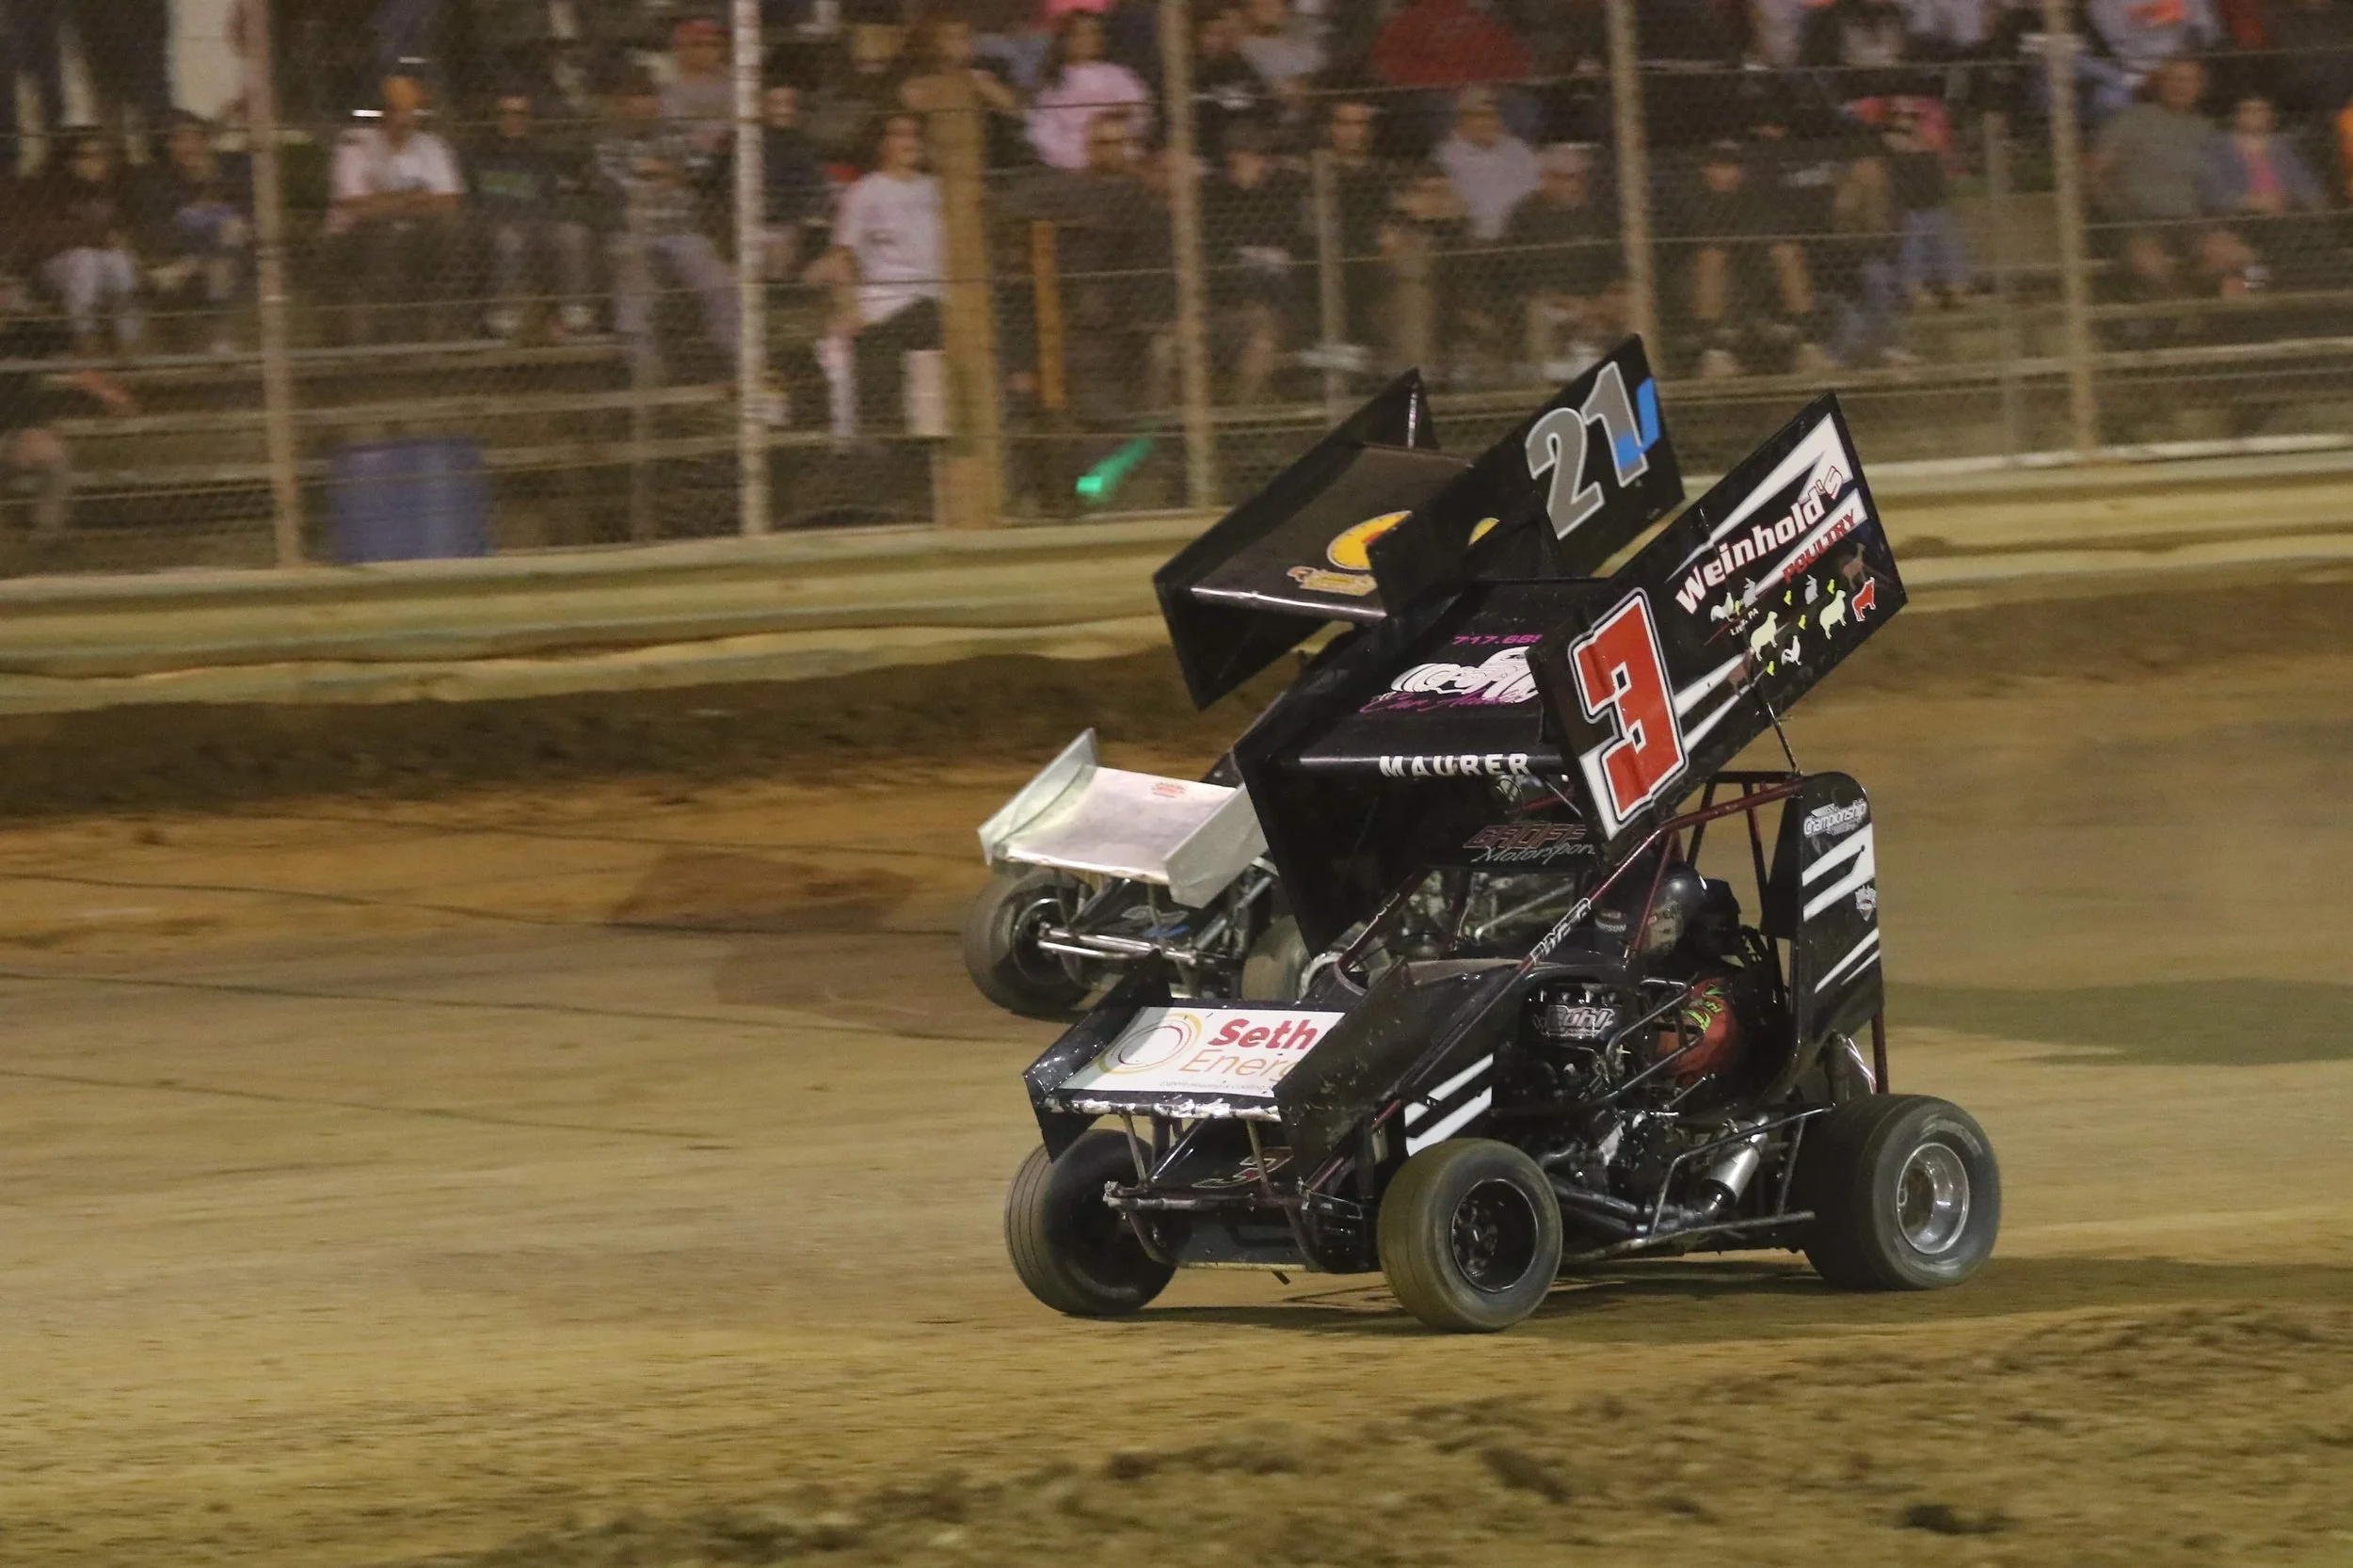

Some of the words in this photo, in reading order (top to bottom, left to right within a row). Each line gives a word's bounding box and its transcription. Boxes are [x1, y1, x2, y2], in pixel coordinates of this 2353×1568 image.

[1675, 465, 1845, 615] Weinhold's
[1782, 508, 1857, 584] POULTRY
[1569, 587, 1688, 828] 3
[1379, 753, 1532, 777] MAURER
[1803, 800, 1868, 838] Championship
[1207, 1018, 1319, 1050] Seth
[1178, 1048, 1300, 1081] Ener
